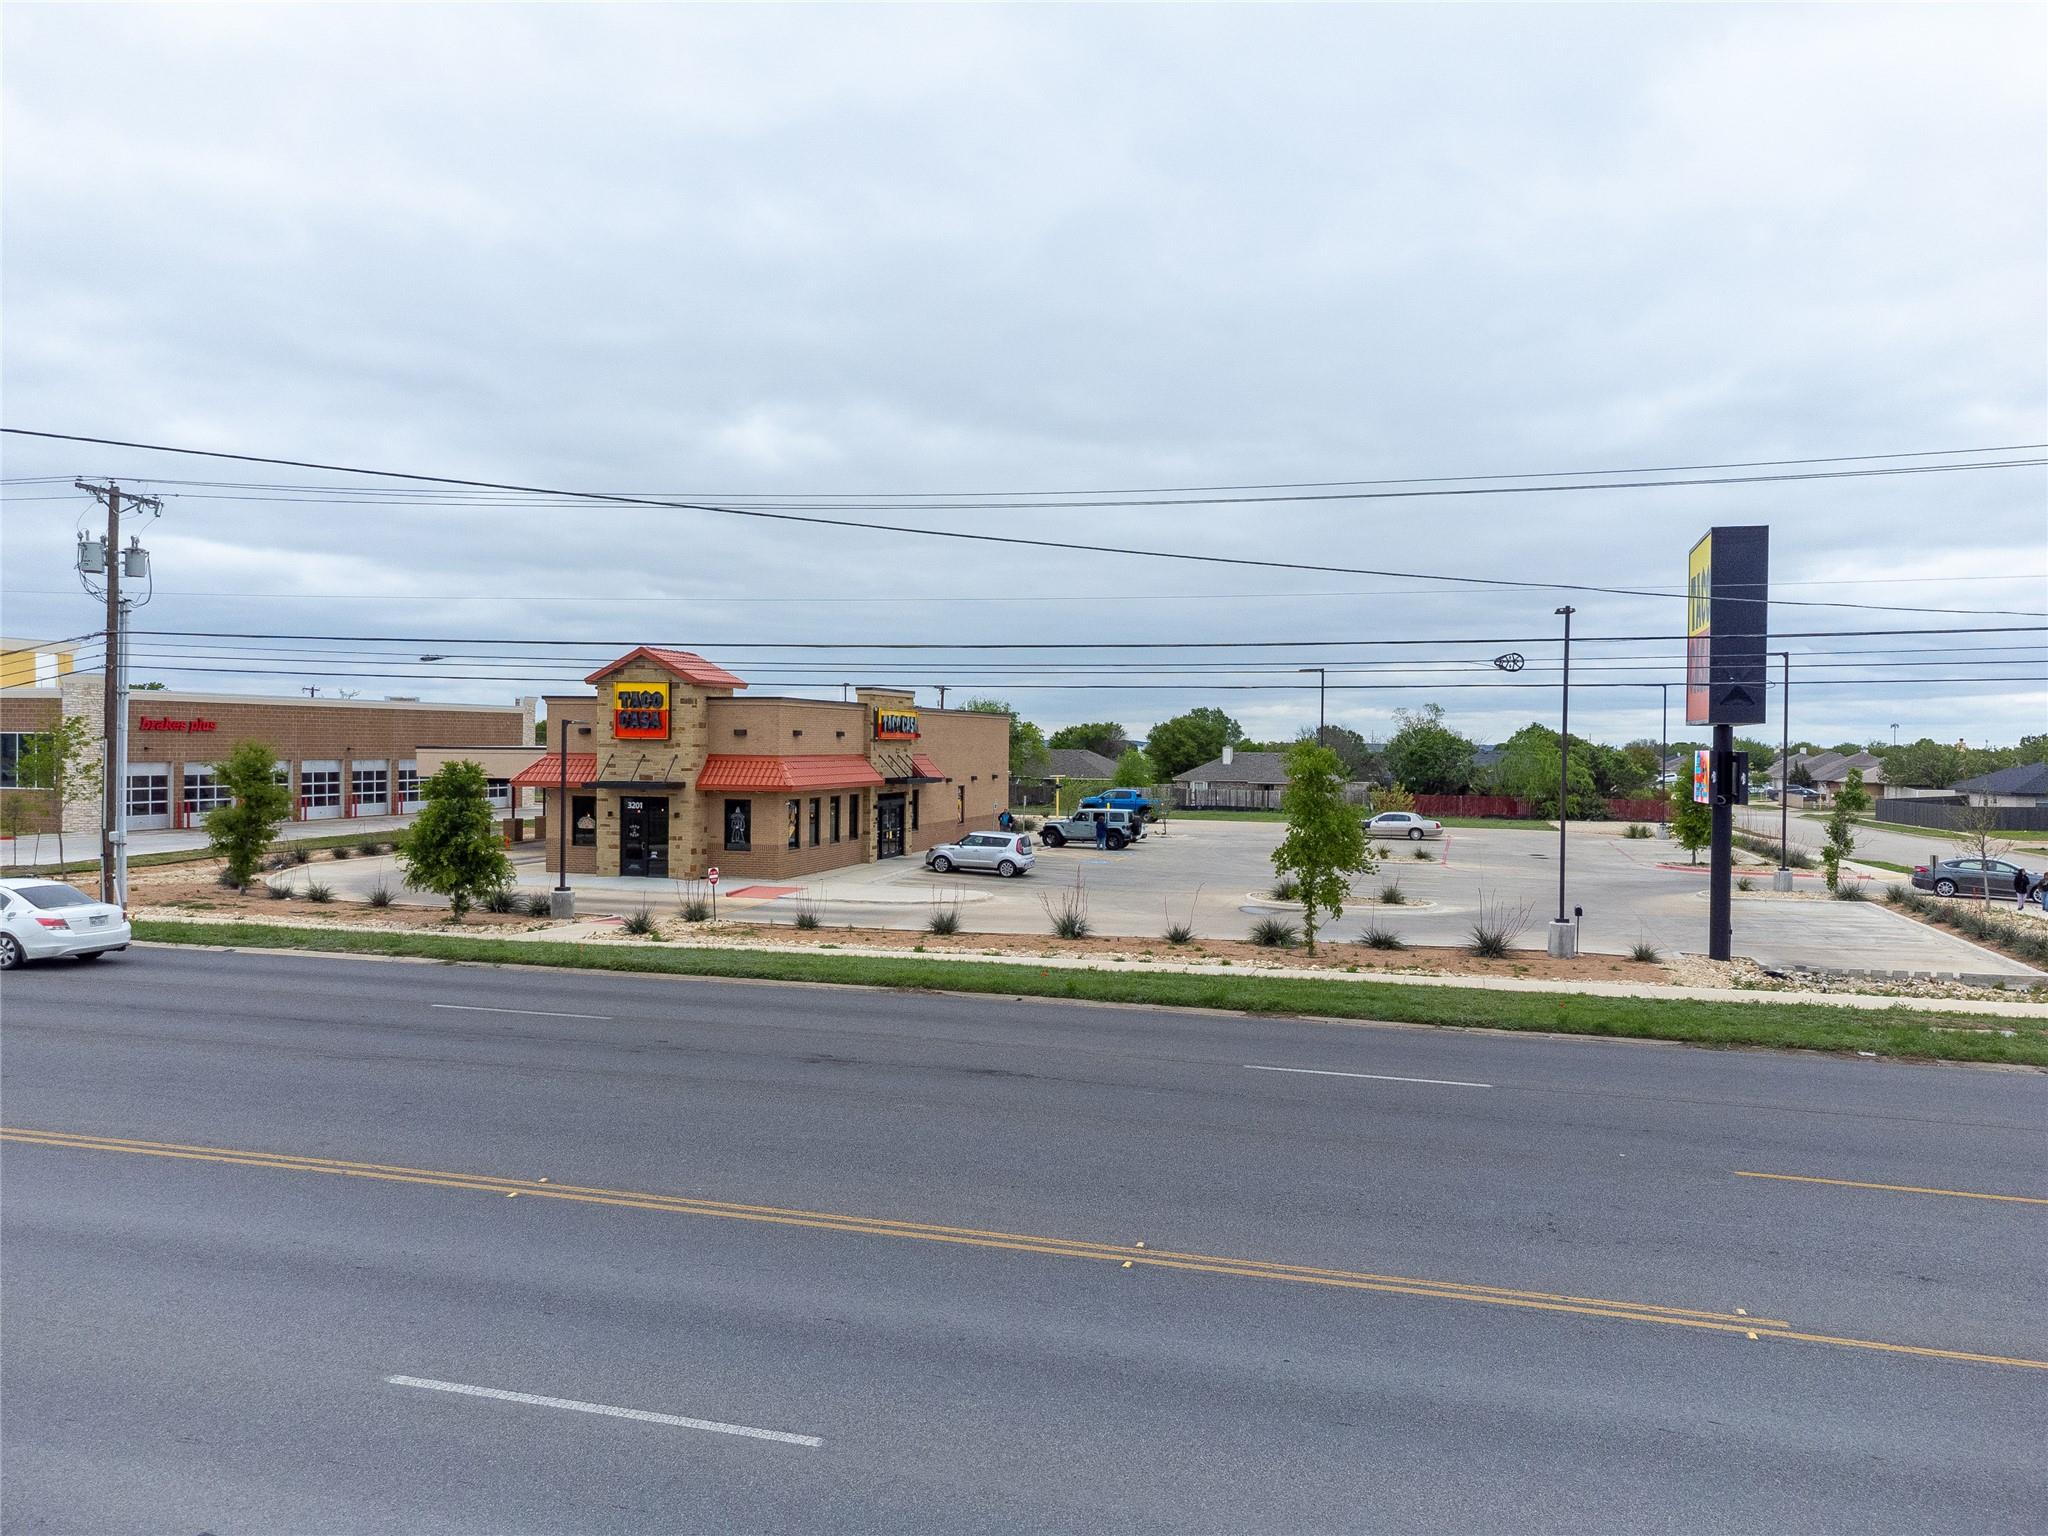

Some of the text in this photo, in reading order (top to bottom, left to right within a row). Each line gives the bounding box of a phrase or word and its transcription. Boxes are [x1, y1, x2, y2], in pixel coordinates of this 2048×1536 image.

[618, 690, 664, 709] TACO
[139, 716, 217, 735] brakes plus
[618, 711, 662, 729] CASA
[882, 715, 902, 733] TACO
[627, 801, 643, 809] 3201
